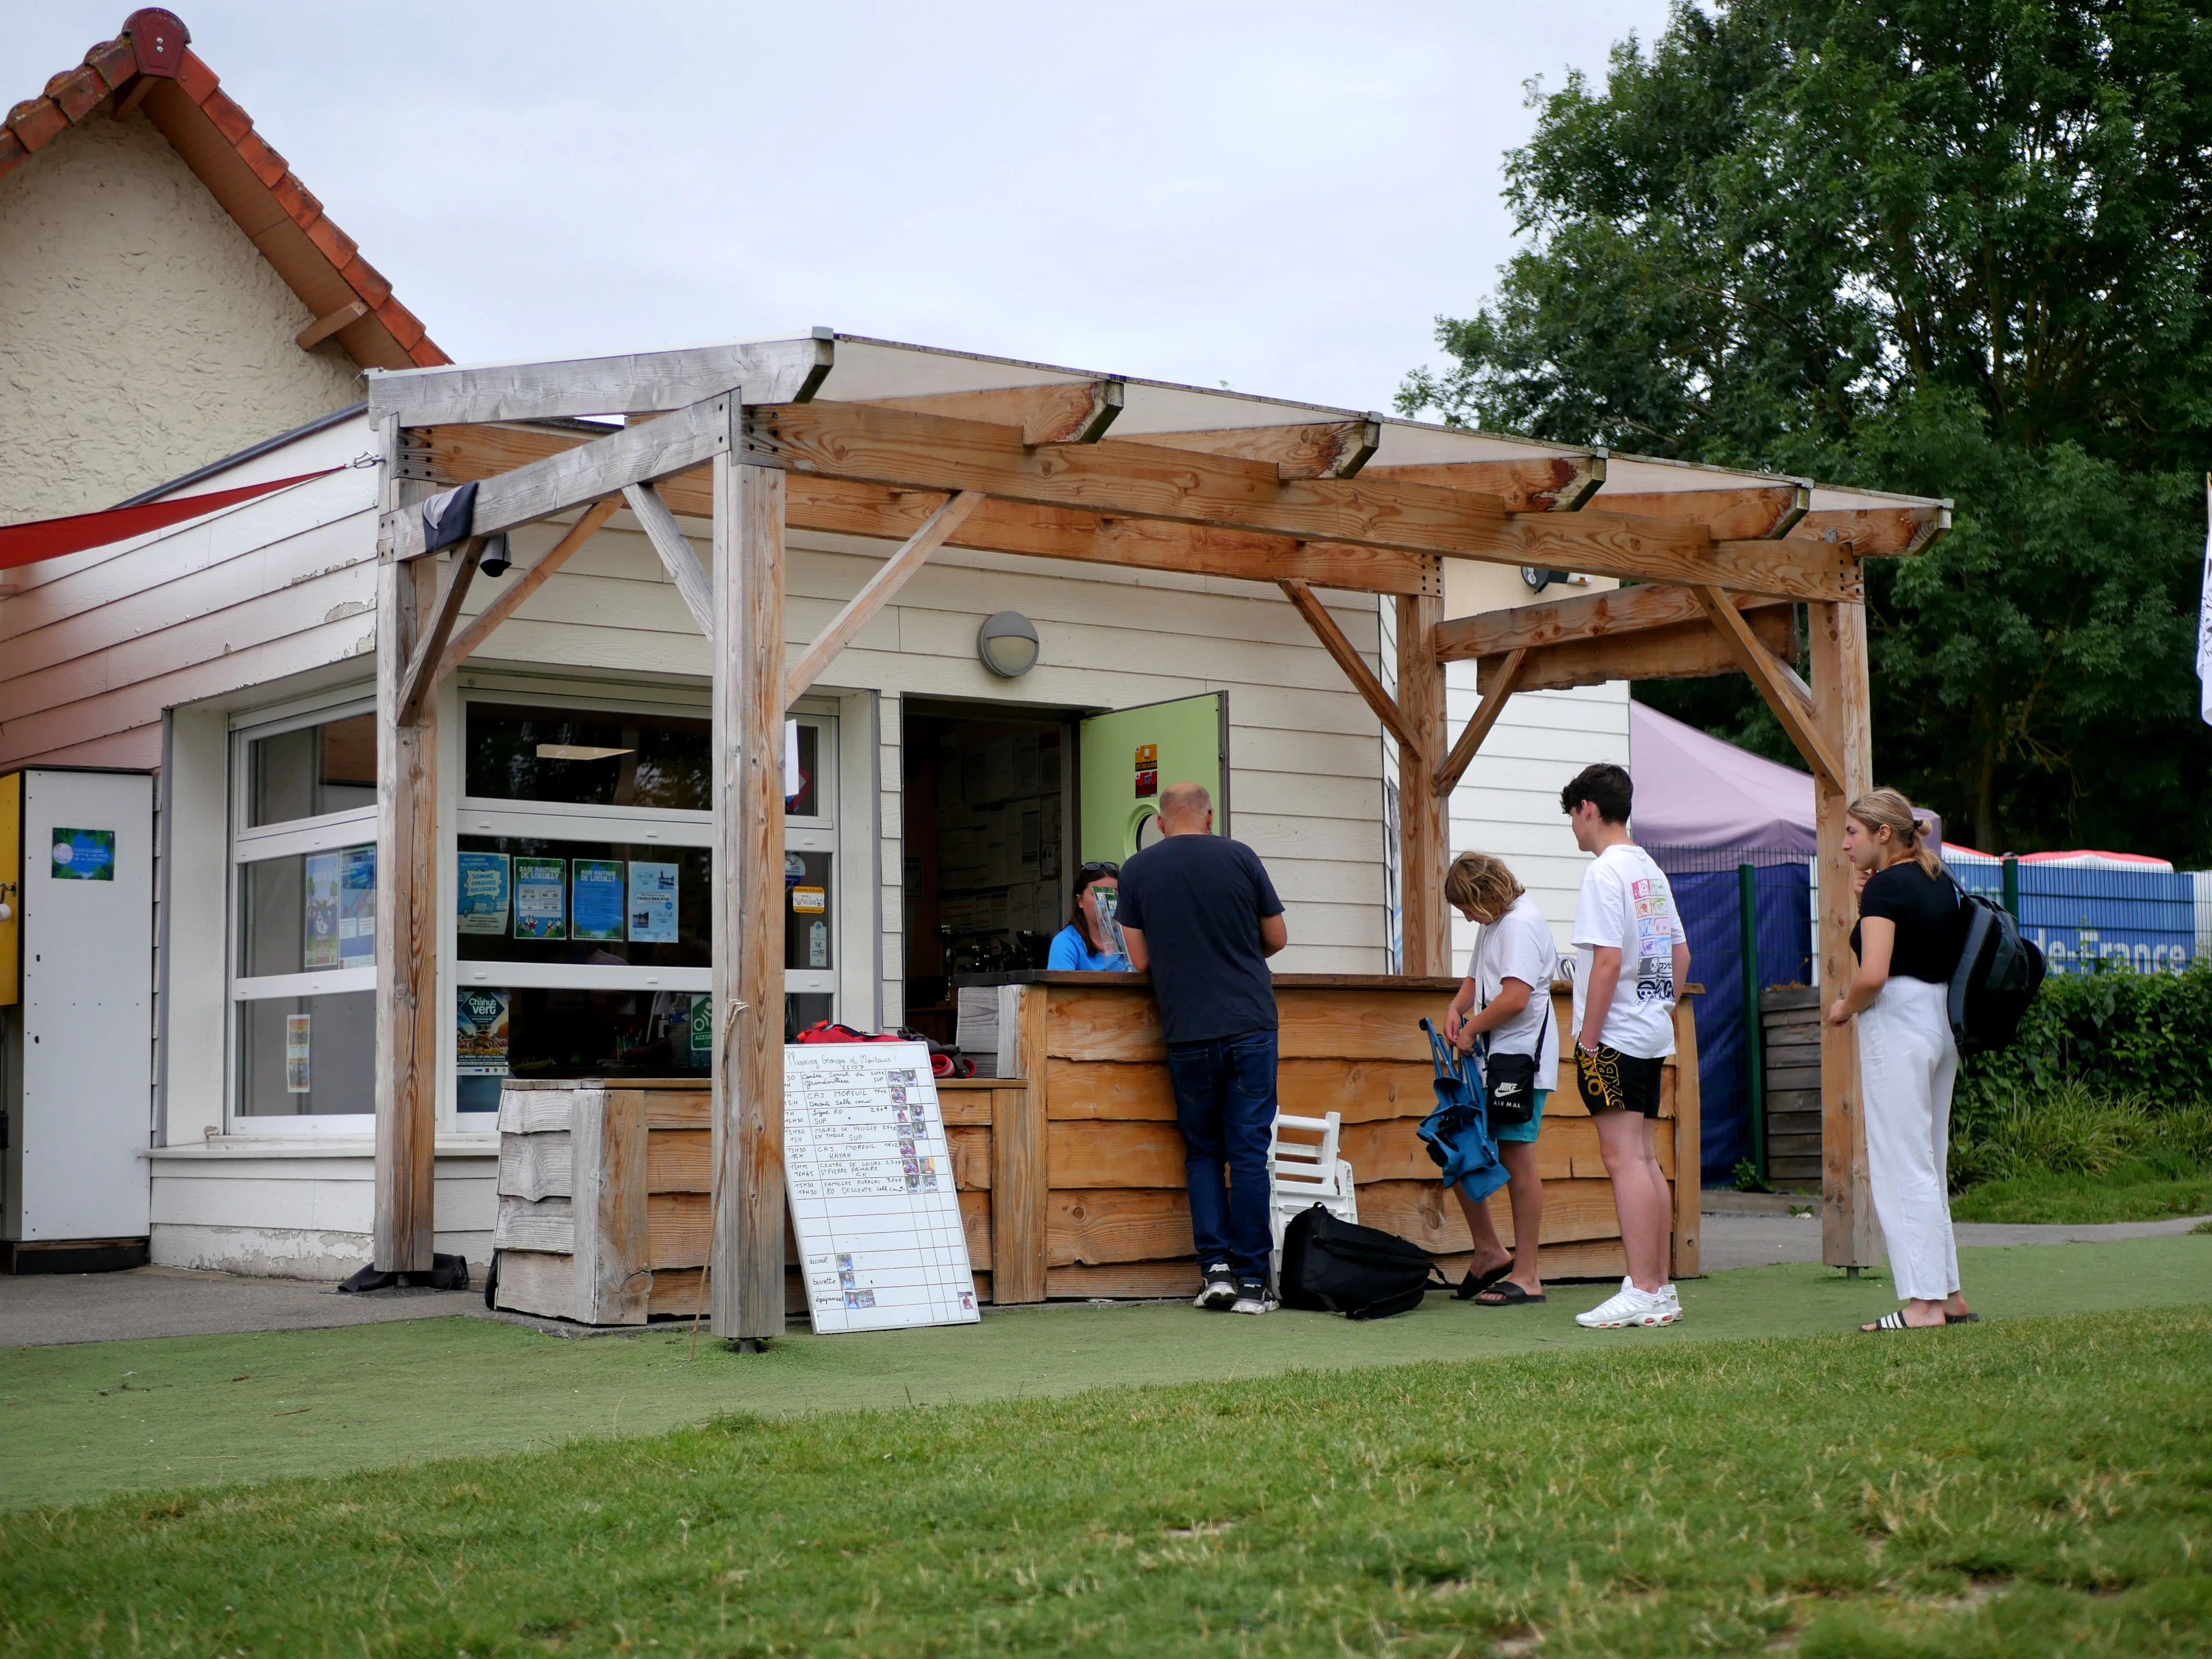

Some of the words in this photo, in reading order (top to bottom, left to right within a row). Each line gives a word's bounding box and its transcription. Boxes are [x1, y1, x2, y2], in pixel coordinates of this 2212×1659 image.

[469, 998, 496, 1006] Chahut
[472, 1006, 496, 1014] vert
[784, 1051, 819, 1069] Planning
[822, 1055, 845, 1067] Groupes
[850, 1056, 858, 1064] et
[1498, 1082, 1518, 1091] NIKE
[809, 1256, 828, 1264] accueil
[813, 1277, 836, 1285] buvette
